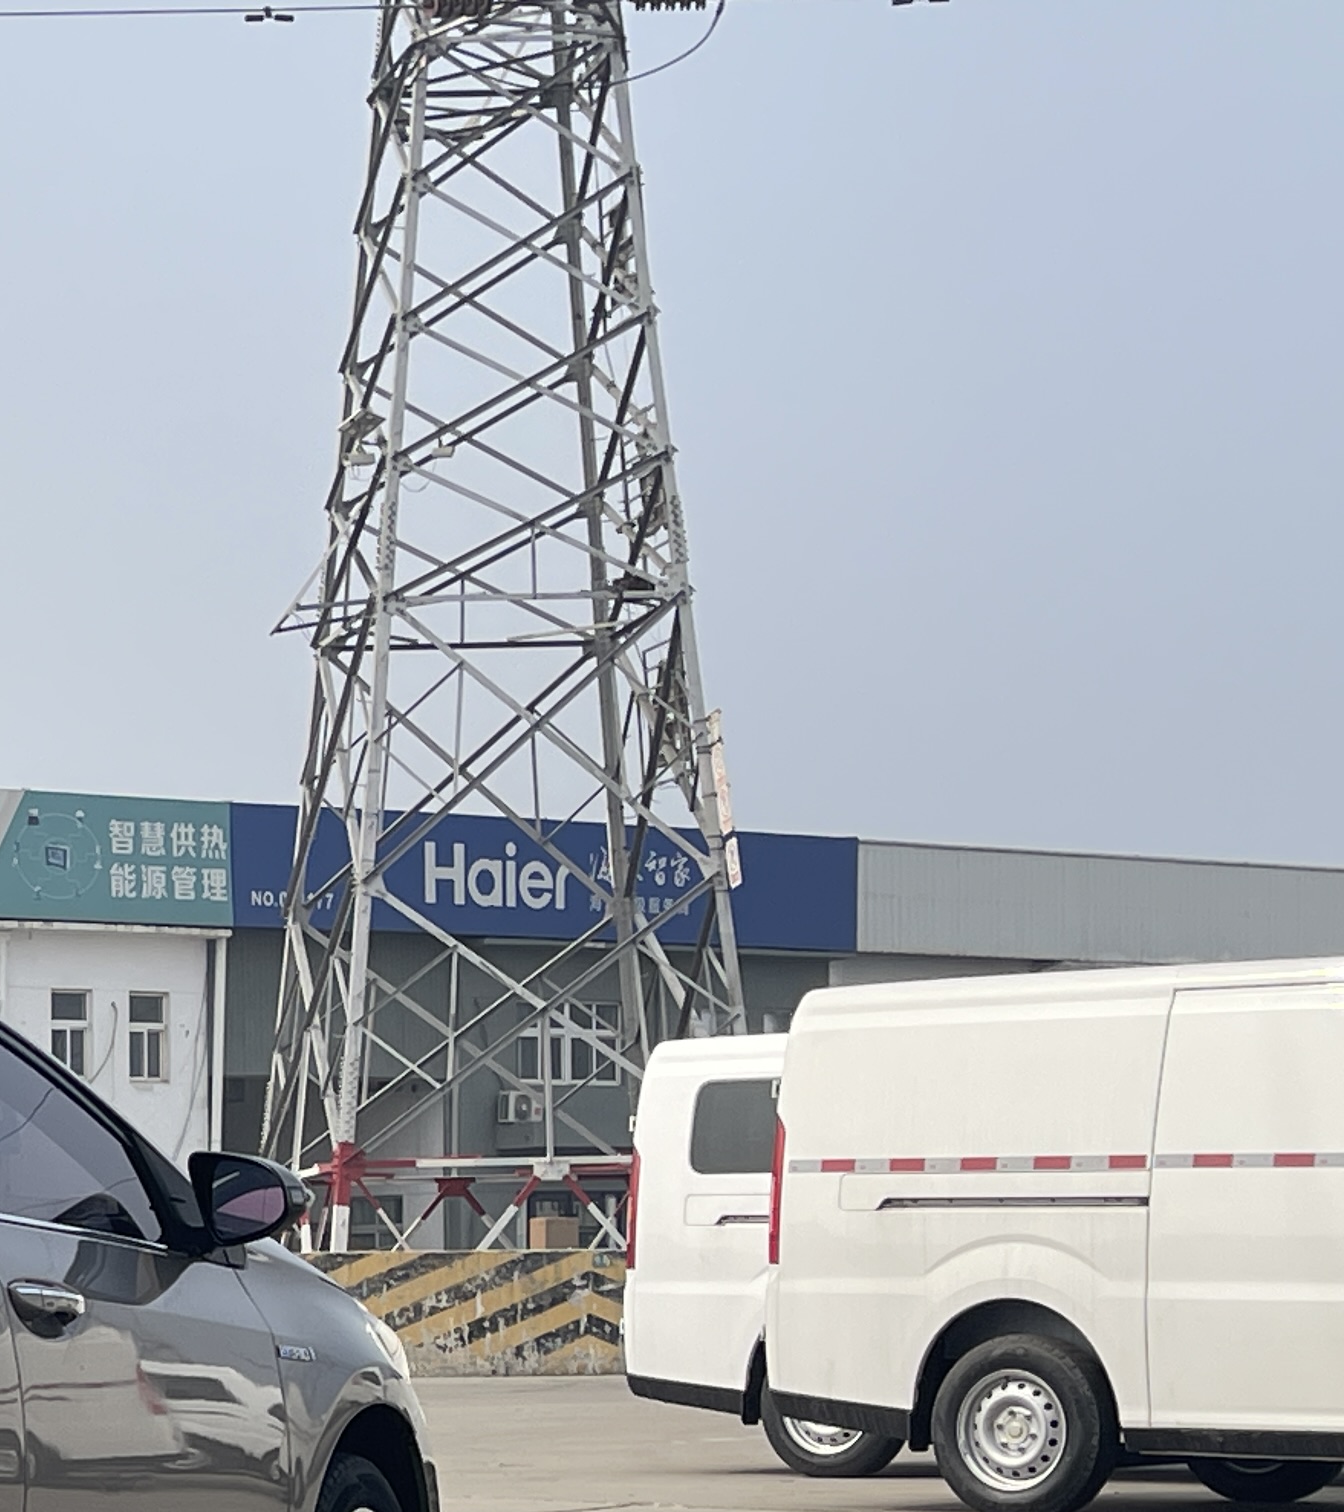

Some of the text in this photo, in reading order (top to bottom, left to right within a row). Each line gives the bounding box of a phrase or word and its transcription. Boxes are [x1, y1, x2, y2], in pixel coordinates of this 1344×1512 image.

[109, 819, 228, 860] 智慧供热
[109, 862, 228, 902] 能源管理
[424, 841, 570, 910] Haier
